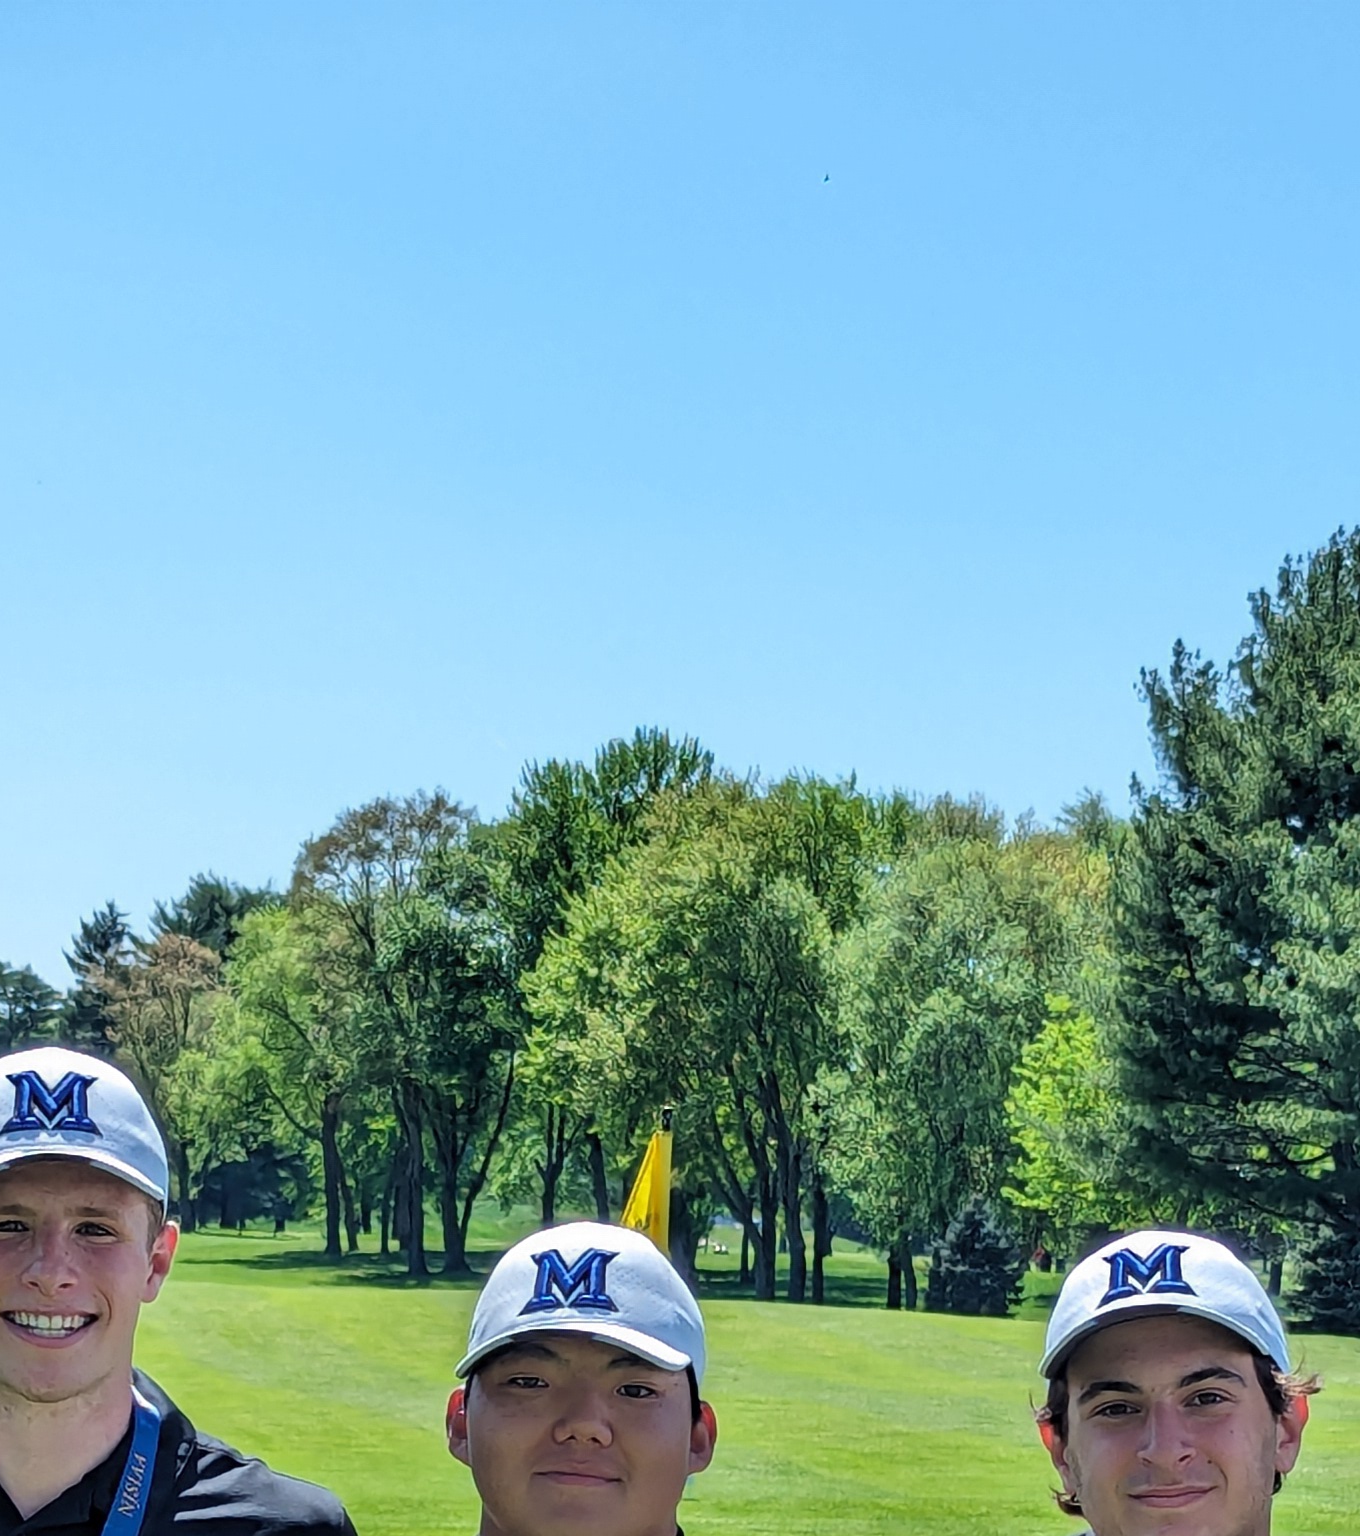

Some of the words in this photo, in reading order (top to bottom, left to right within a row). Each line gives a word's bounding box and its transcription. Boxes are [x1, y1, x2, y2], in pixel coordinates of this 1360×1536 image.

[517, 1248, 621, 1316] M
[1095, 1243, 1200, 1310] M
[117, 1451, 147, 1518] NJSIAA
